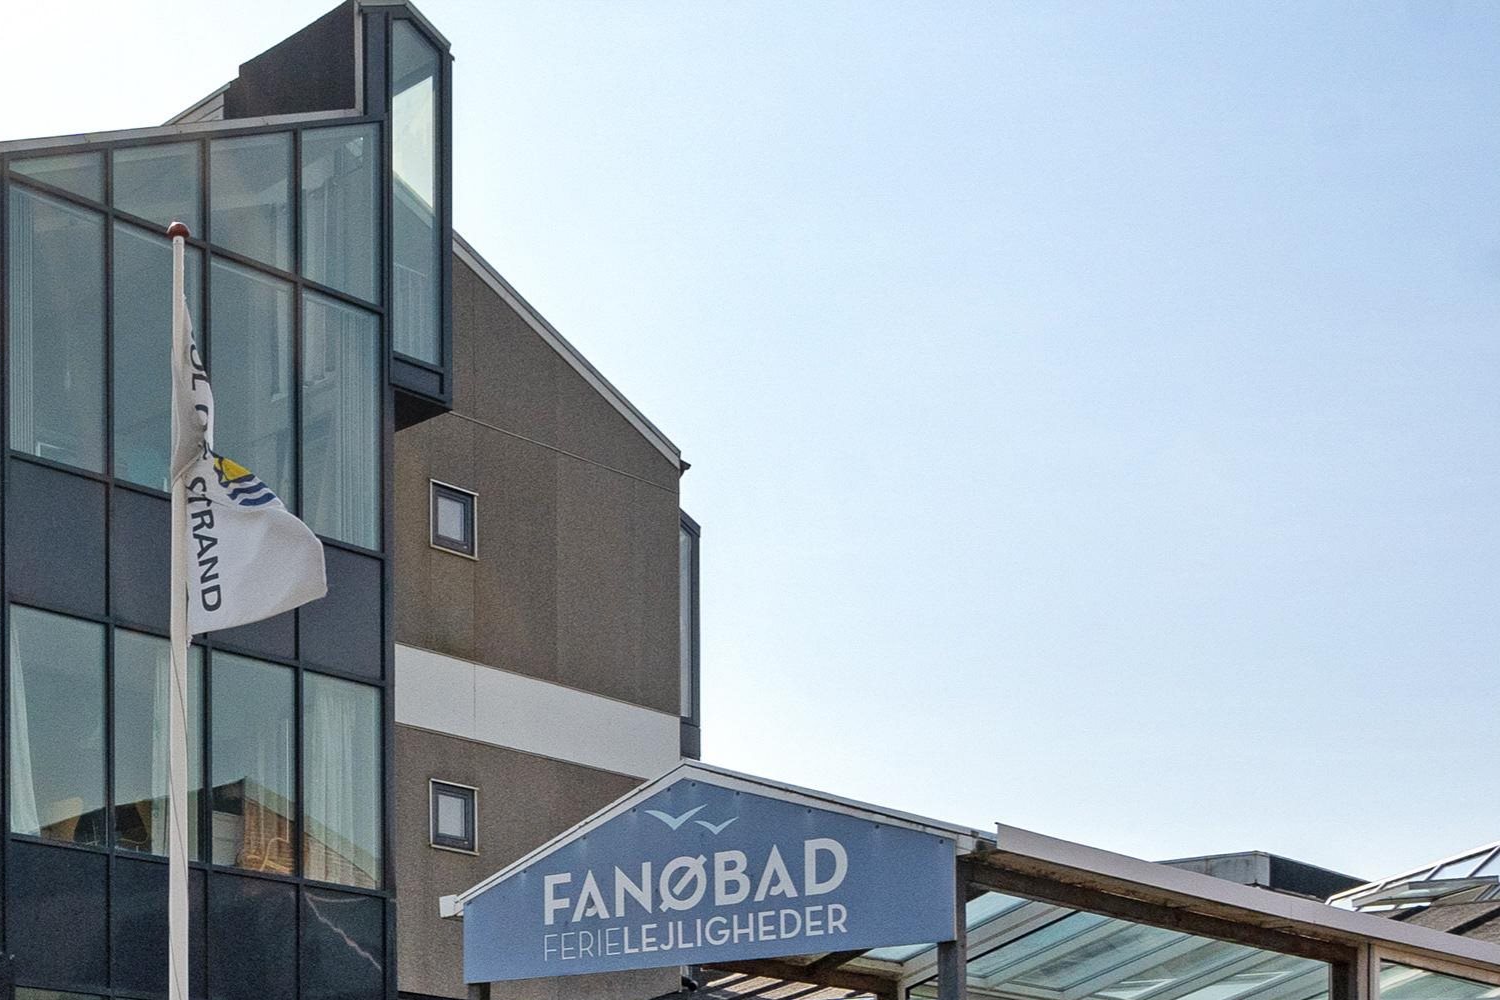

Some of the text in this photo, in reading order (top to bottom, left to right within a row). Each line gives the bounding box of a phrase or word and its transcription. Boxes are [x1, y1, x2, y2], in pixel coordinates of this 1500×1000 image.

[186, 476, 222, 612] STRAND
[543, 838, 848, 926] FANØBAD
[543, 904, 848, 962] FERIELEJLIGHEDER
